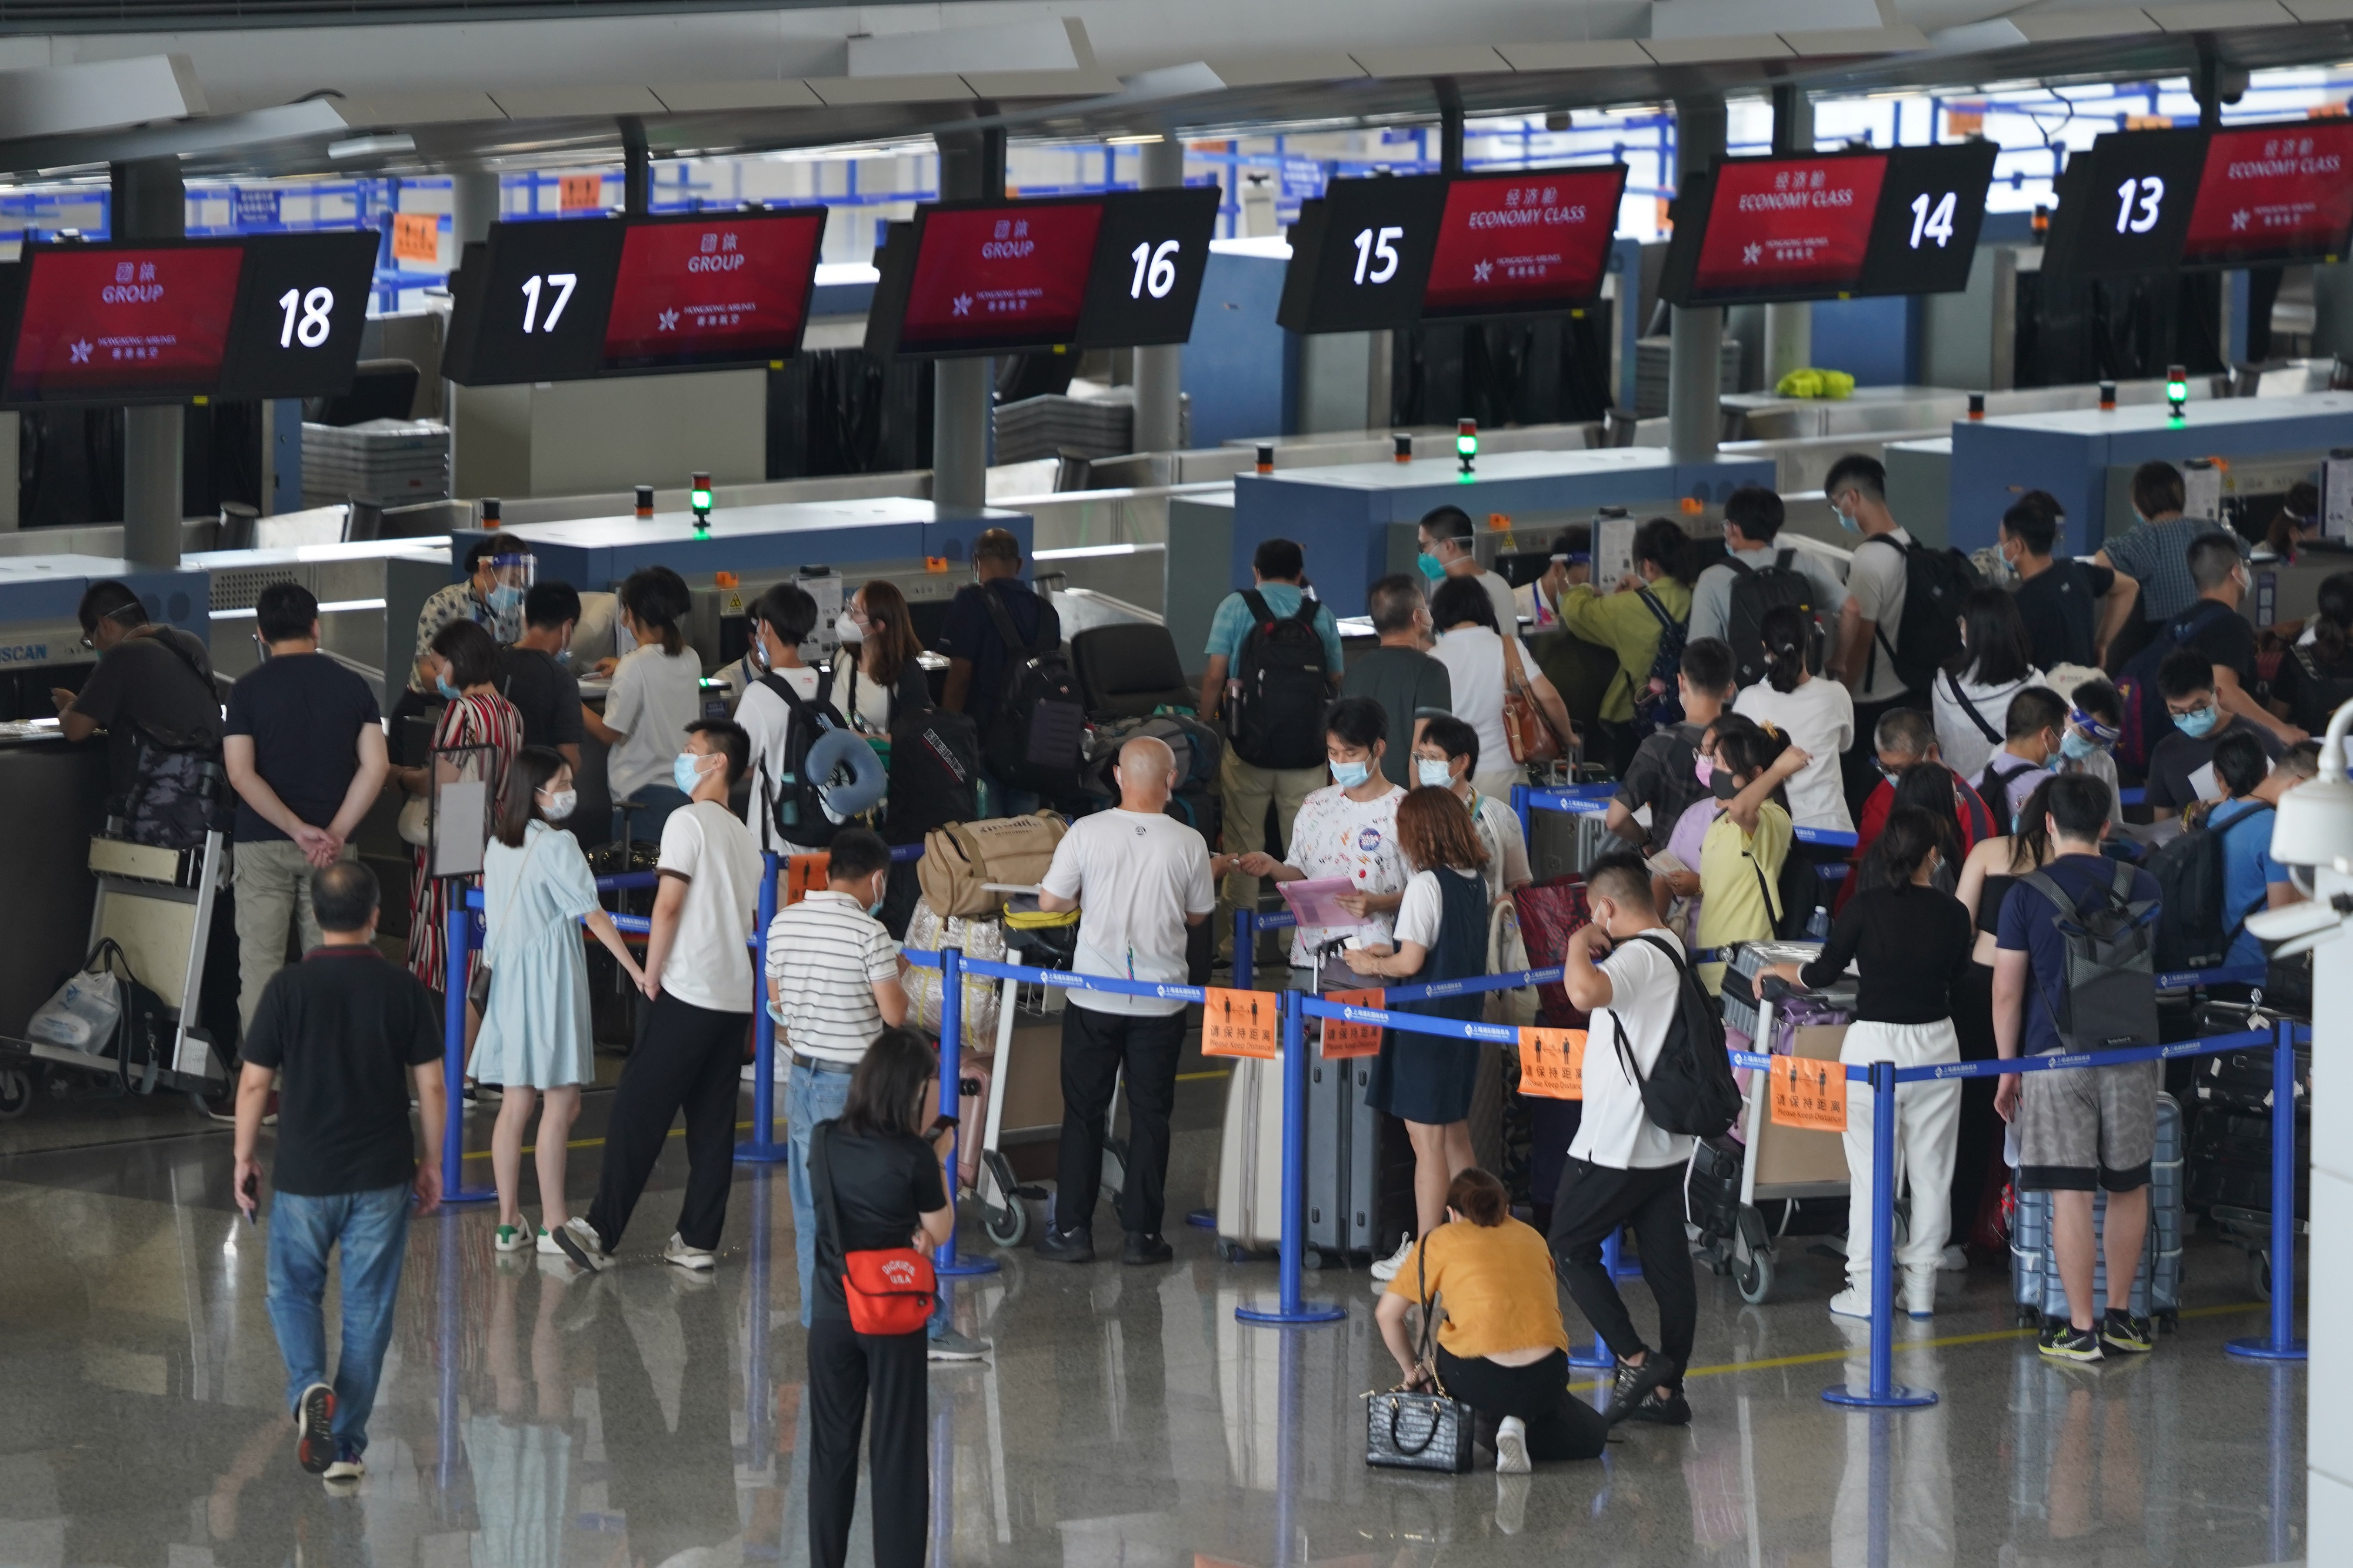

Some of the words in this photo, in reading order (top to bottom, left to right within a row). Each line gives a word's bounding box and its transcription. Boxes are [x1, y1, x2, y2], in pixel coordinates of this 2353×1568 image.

[2228, 158, 2299, 179] ECONOMY
[2300, 155, 2341, 174] CLASS
[1739, 191, 1810, 211] ECONOMY
[1812, 188, 1853, 208] CLASS
[2117, 176, 2164, 233] 13
[1469, 208, 1542, 228] ECONOMY
[1544, 205, 1587, 225] CLASS
[1909, 192, 1957, 249] 14
[982, 240, 1034, 259] GROUP
[1354, 226, 1403, 285] 15
[688, 253, 745, 273] GROUP
[1130, 240, 1179, 299] 16
[102, 284, 164, 303] GROUP
[521, 273, 577, 333] 17
[279, 287, 334, 348] 18
[923, 728, 966, 784] HELIX
[1210, 1025, 1271, 1042] 请保持距离
[1209, 1039, 1228, 1047] Please
[1230, 1040, 1245, 1050] Keep
[1247, 1043, 1271, 1052] Distance
[1525, 1079, 1542, 1087] Please
[1544, 1080, 1559, 1089] Keep
[1777, 1093, 1840, 1113] 请保持距离
[1778, 1109, 1796, 1117] Please
[1797, 1112, 1814, 1120] Keep
[1815, 1113, 1842, 1123] Distance
[882, 1260, 915, 1277] DICKIES
